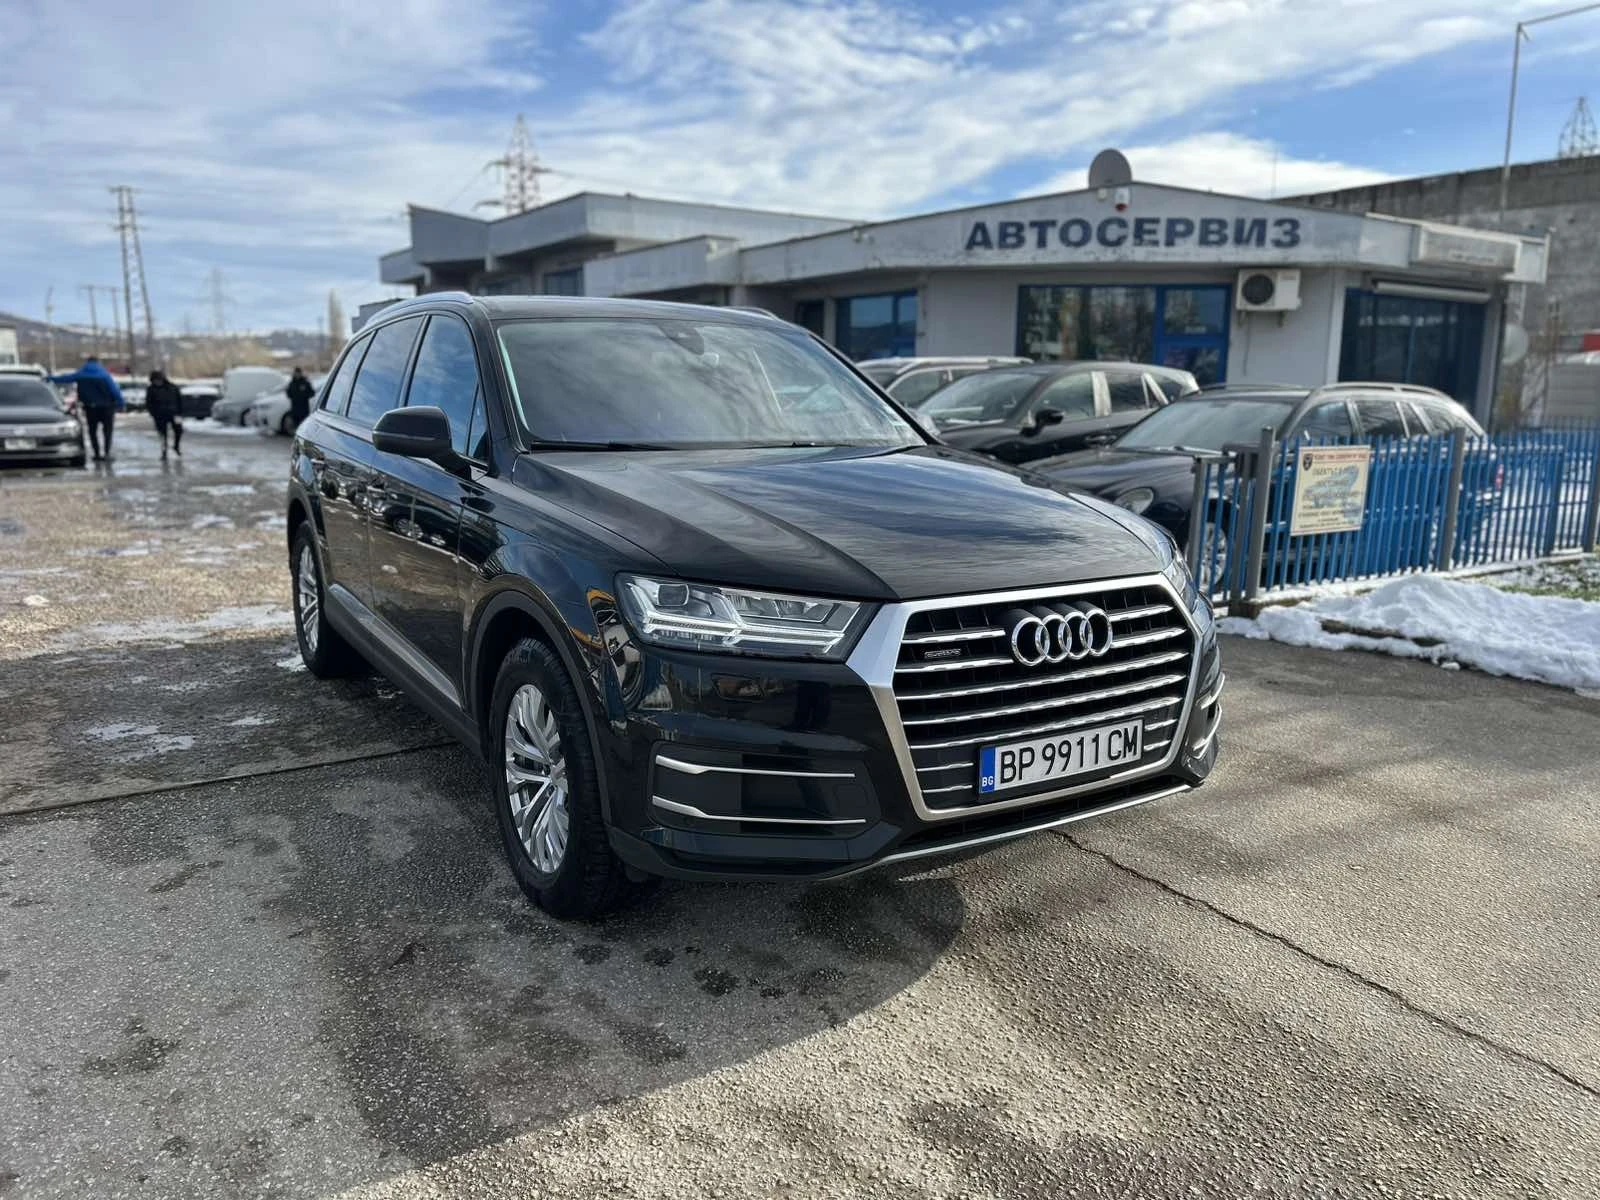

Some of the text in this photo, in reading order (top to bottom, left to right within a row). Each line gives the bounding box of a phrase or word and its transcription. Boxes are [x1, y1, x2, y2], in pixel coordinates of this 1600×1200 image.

[965, 217, 1301, 250] АВТОСЕРВИЗ
[1000, 725, 1139, 784] BP 9911 CM
[981, 775, 994, 787] BG
